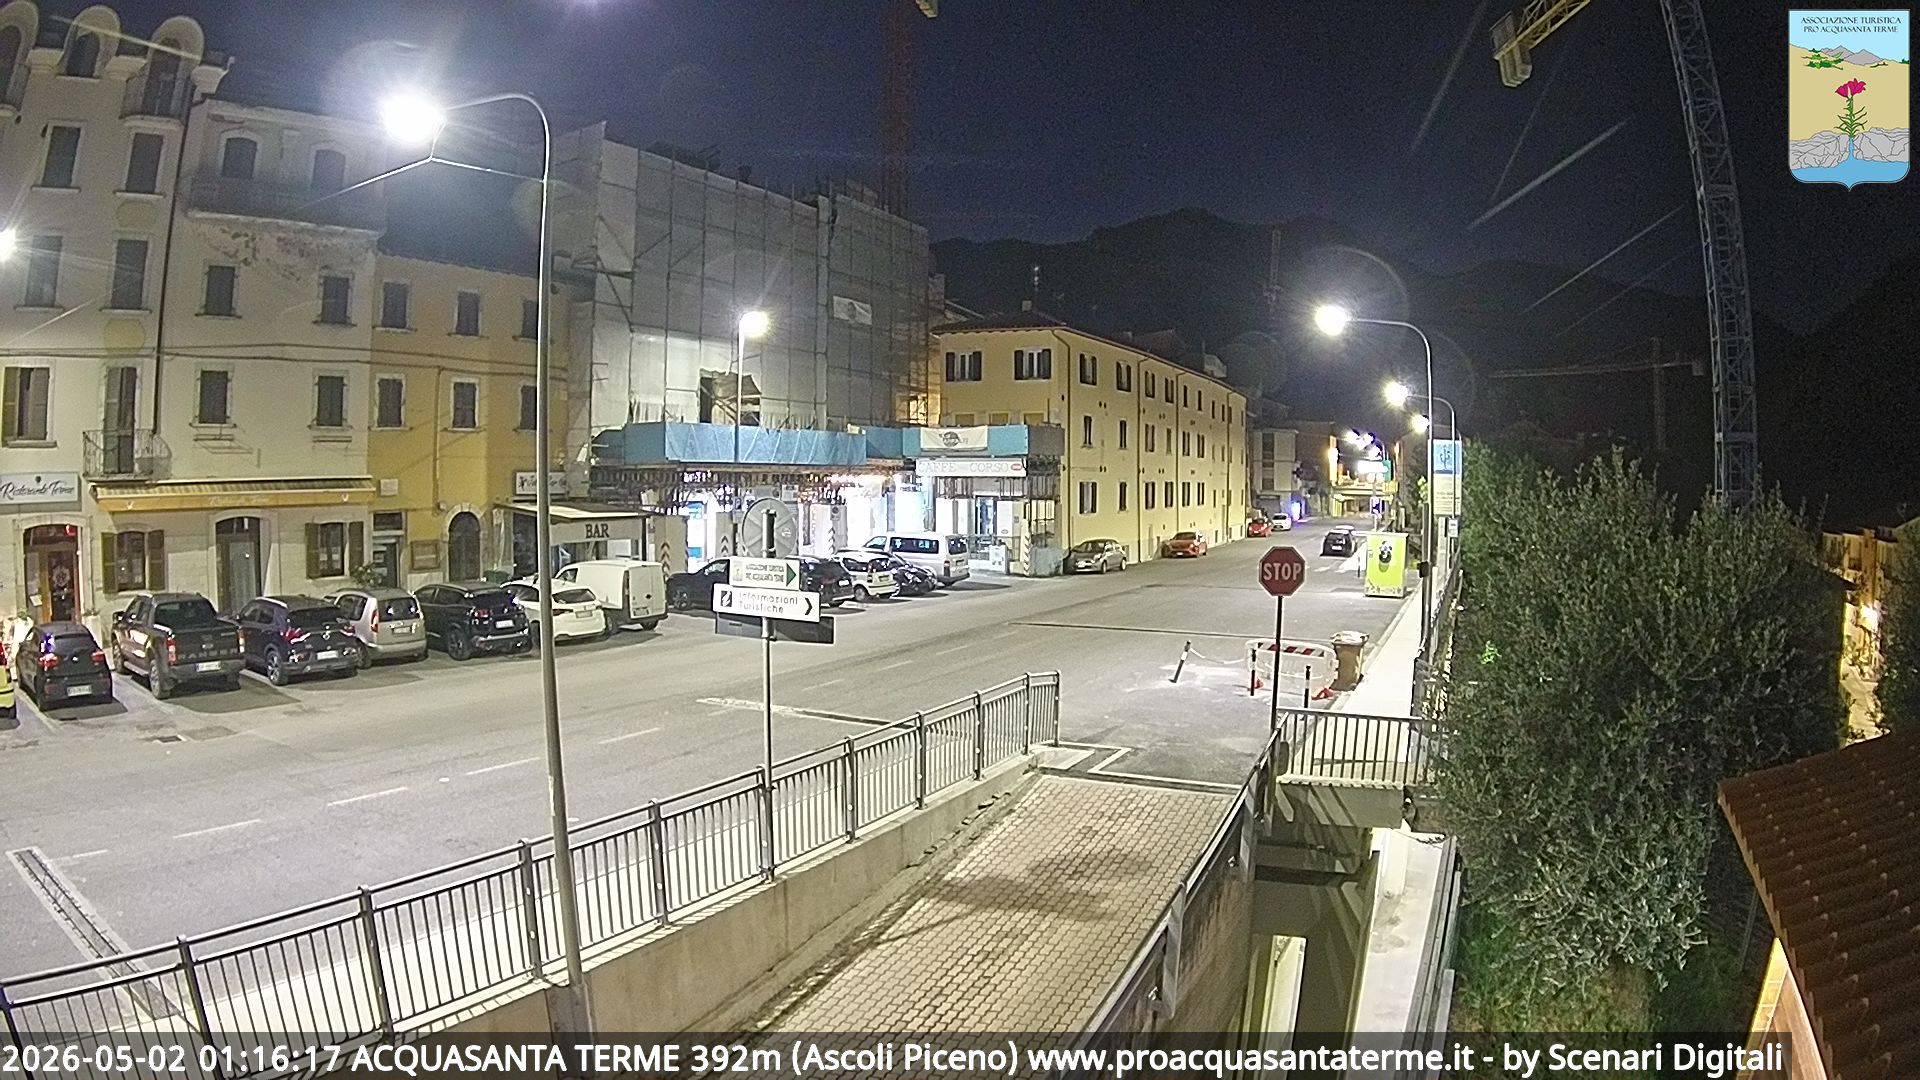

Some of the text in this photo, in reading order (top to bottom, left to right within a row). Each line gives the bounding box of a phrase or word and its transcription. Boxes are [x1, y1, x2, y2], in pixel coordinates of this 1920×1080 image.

[969, 463, 1009, 473] CORSO
[585, 523, 610, 538] BAR
[1263, 562, 1302, 581] STOP
